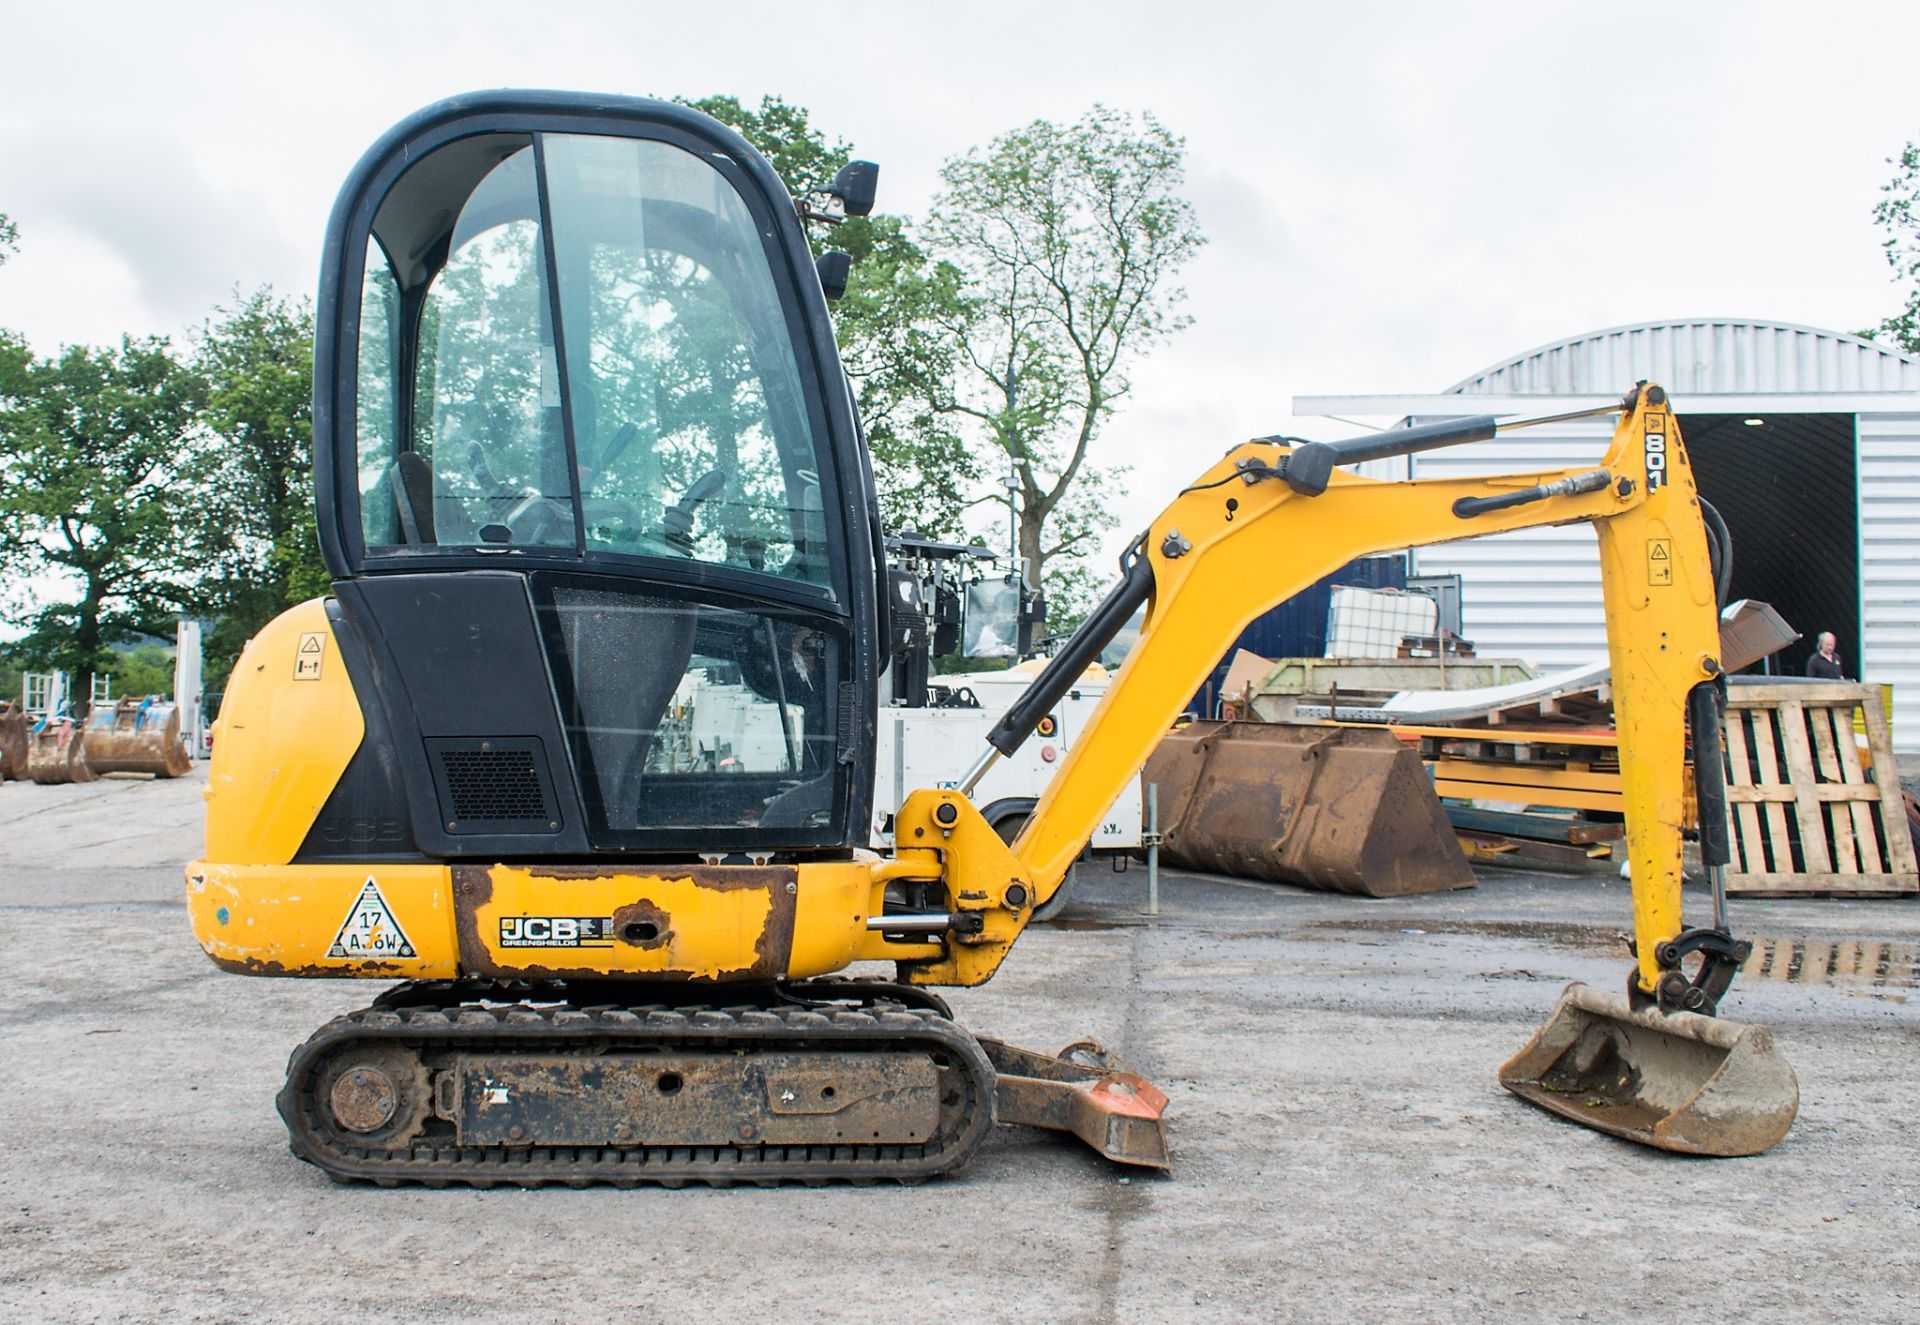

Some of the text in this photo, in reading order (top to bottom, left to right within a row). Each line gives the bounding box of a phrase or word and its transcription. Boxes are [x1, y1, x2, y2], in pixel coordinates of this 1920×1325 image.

[323, 817, 404, 841] JCB
[360, 912, 381, 928] 17
[502, 919, 578, 940] JCB
